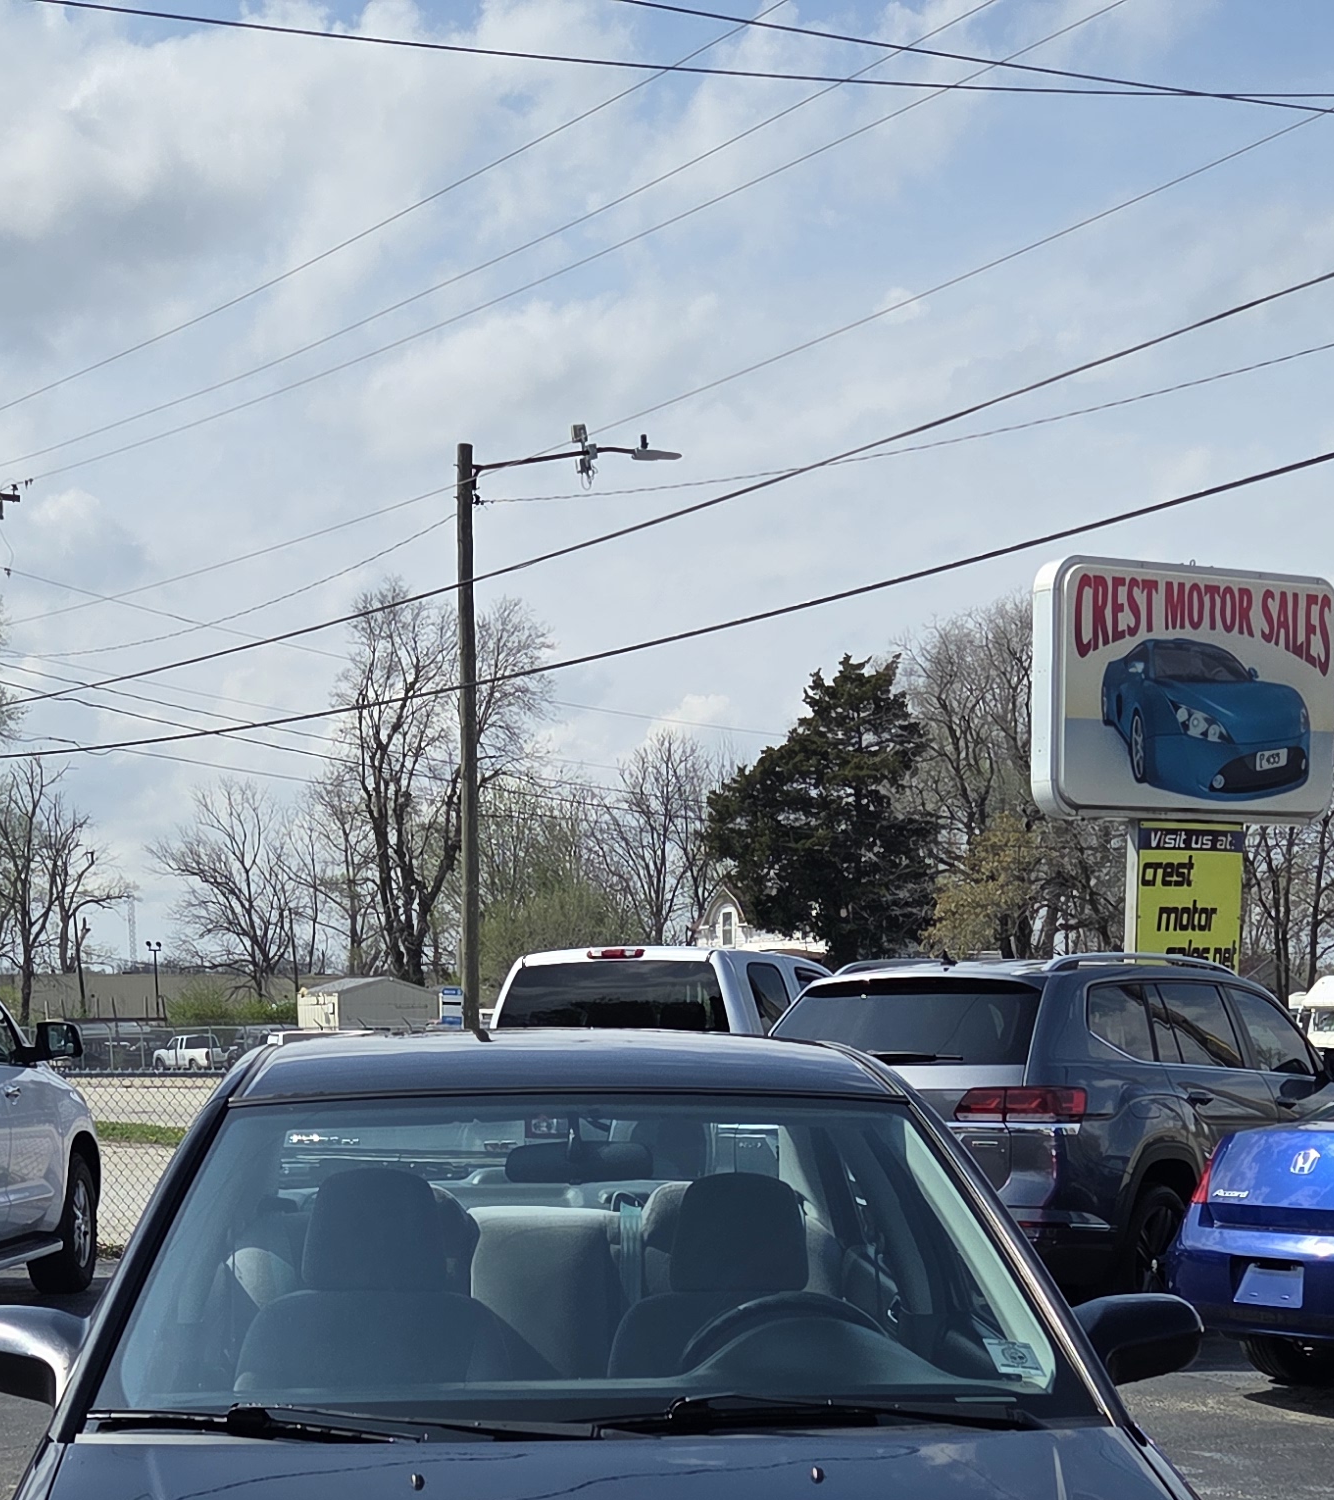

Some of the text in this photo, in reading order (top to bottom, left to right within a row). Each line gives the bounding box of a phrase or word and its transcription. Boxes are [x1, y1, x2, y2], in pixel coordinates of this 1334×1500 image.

[1074, 573, 1332, 677] CREST MOTOR SALES
[1150, 830, 1236, 850] Visit us at:
[1141, 854, 1195, 888] crest
[1156, 899, 1218, 932] motor
